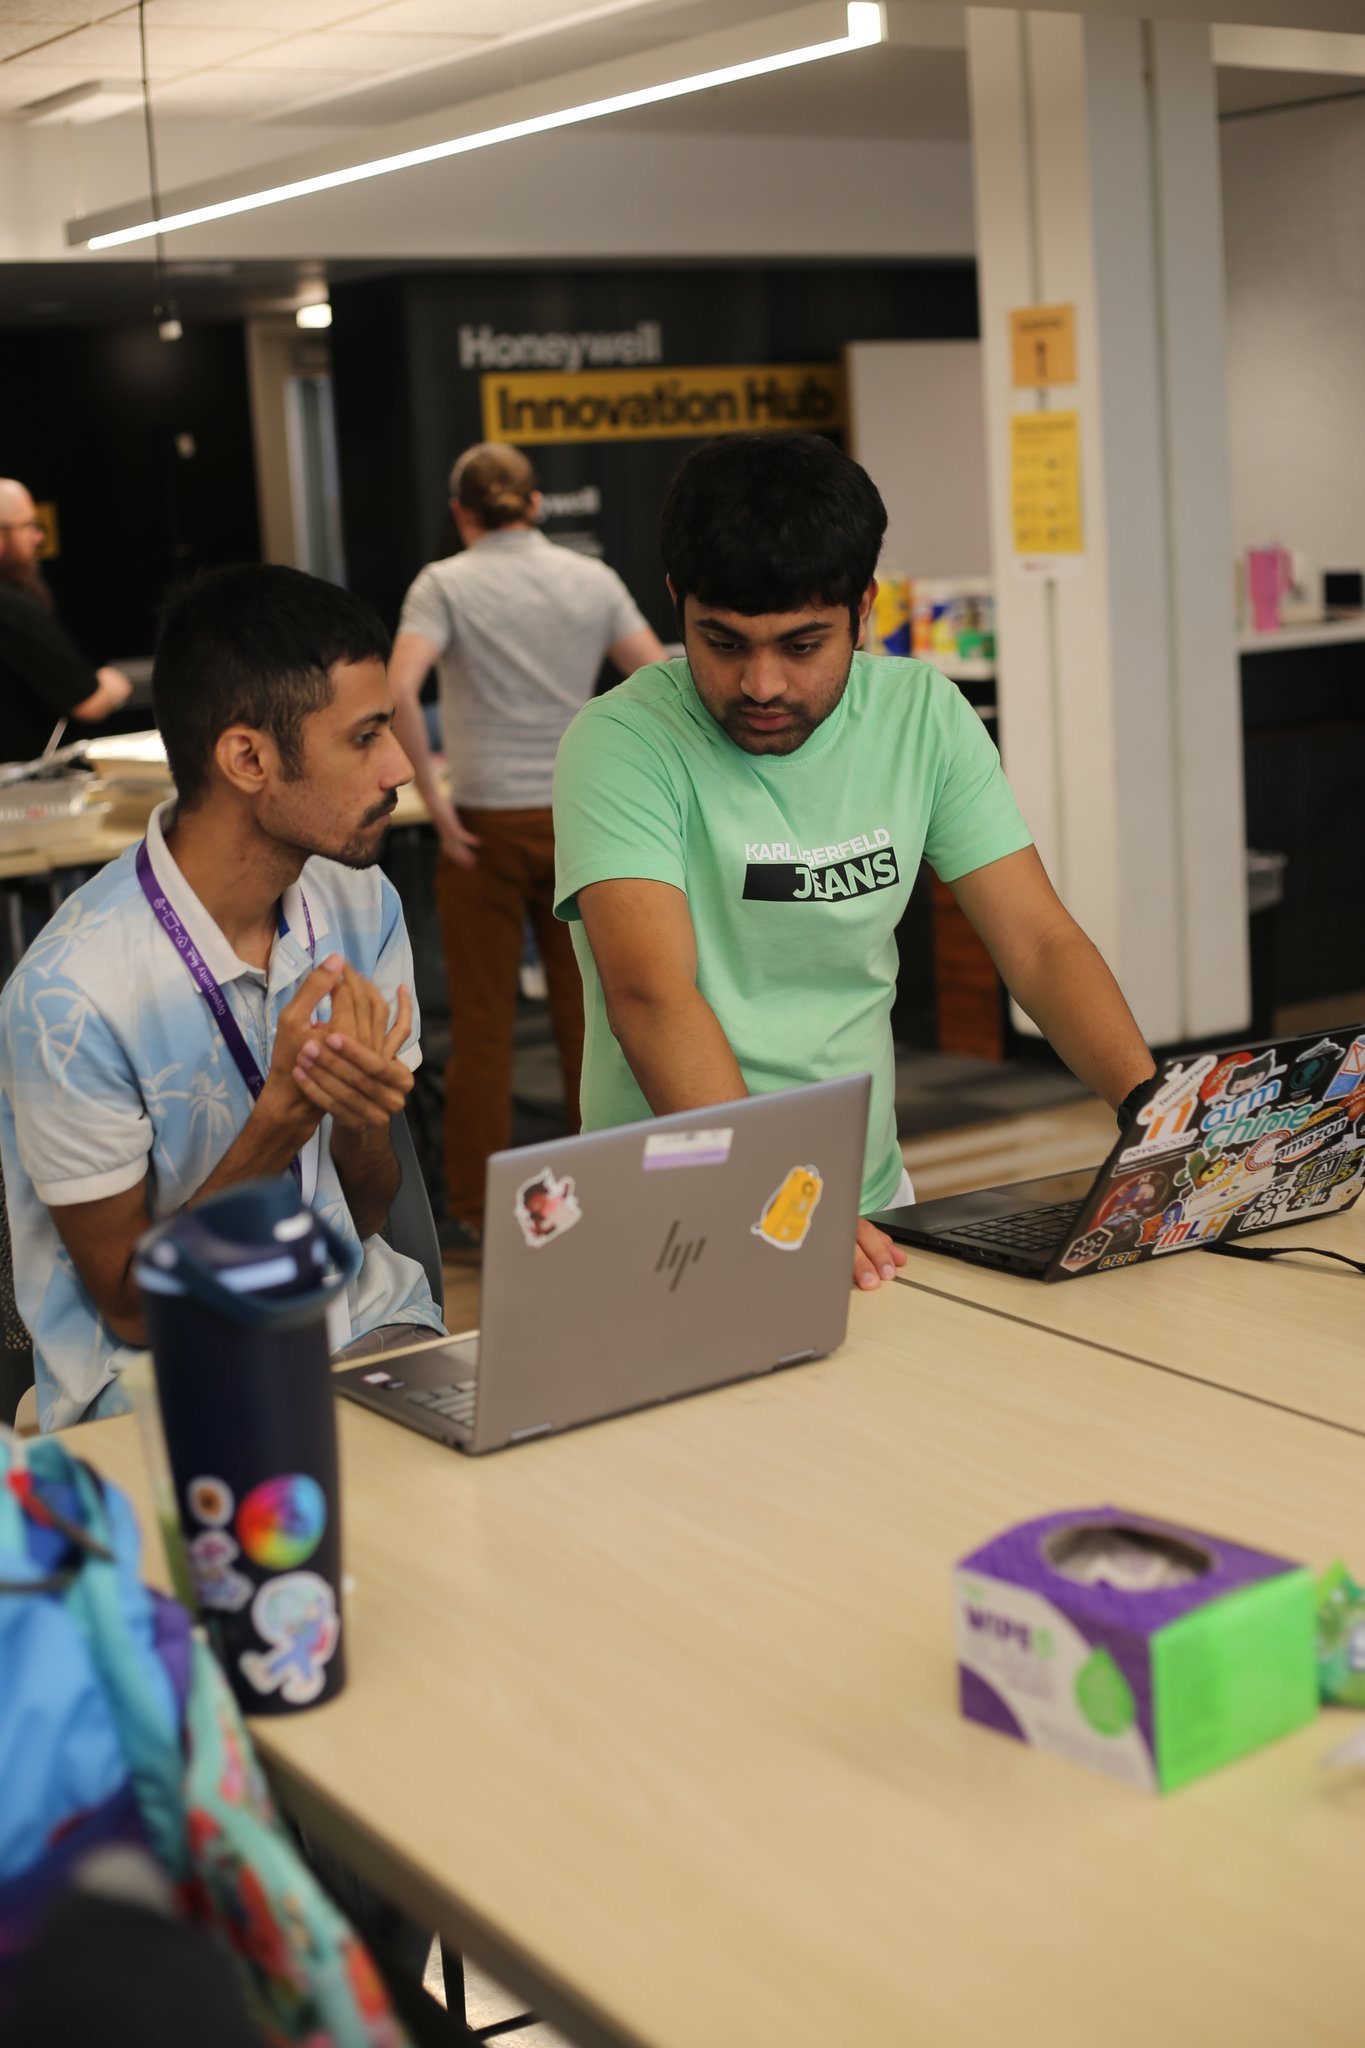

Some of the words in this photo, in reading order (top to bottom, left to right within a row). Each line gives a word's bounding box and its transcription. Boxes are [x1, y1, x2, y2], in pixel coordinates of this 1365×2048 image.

[459, 322, 661, 372] Honeywell
[498, 379, 738, 432] Innovation
[745, 372, 834, 421] Hub
[745, 843, 797, 861] KARL
[793, 852, 896, 899] JEANS
[197, 966, 226, 1016] Opportunity
[1203, 1080, 1280, 1130] arm
[1205, 1105, 1313, 1149] chime
[1274, 1118, 1347, 1160] amazon
